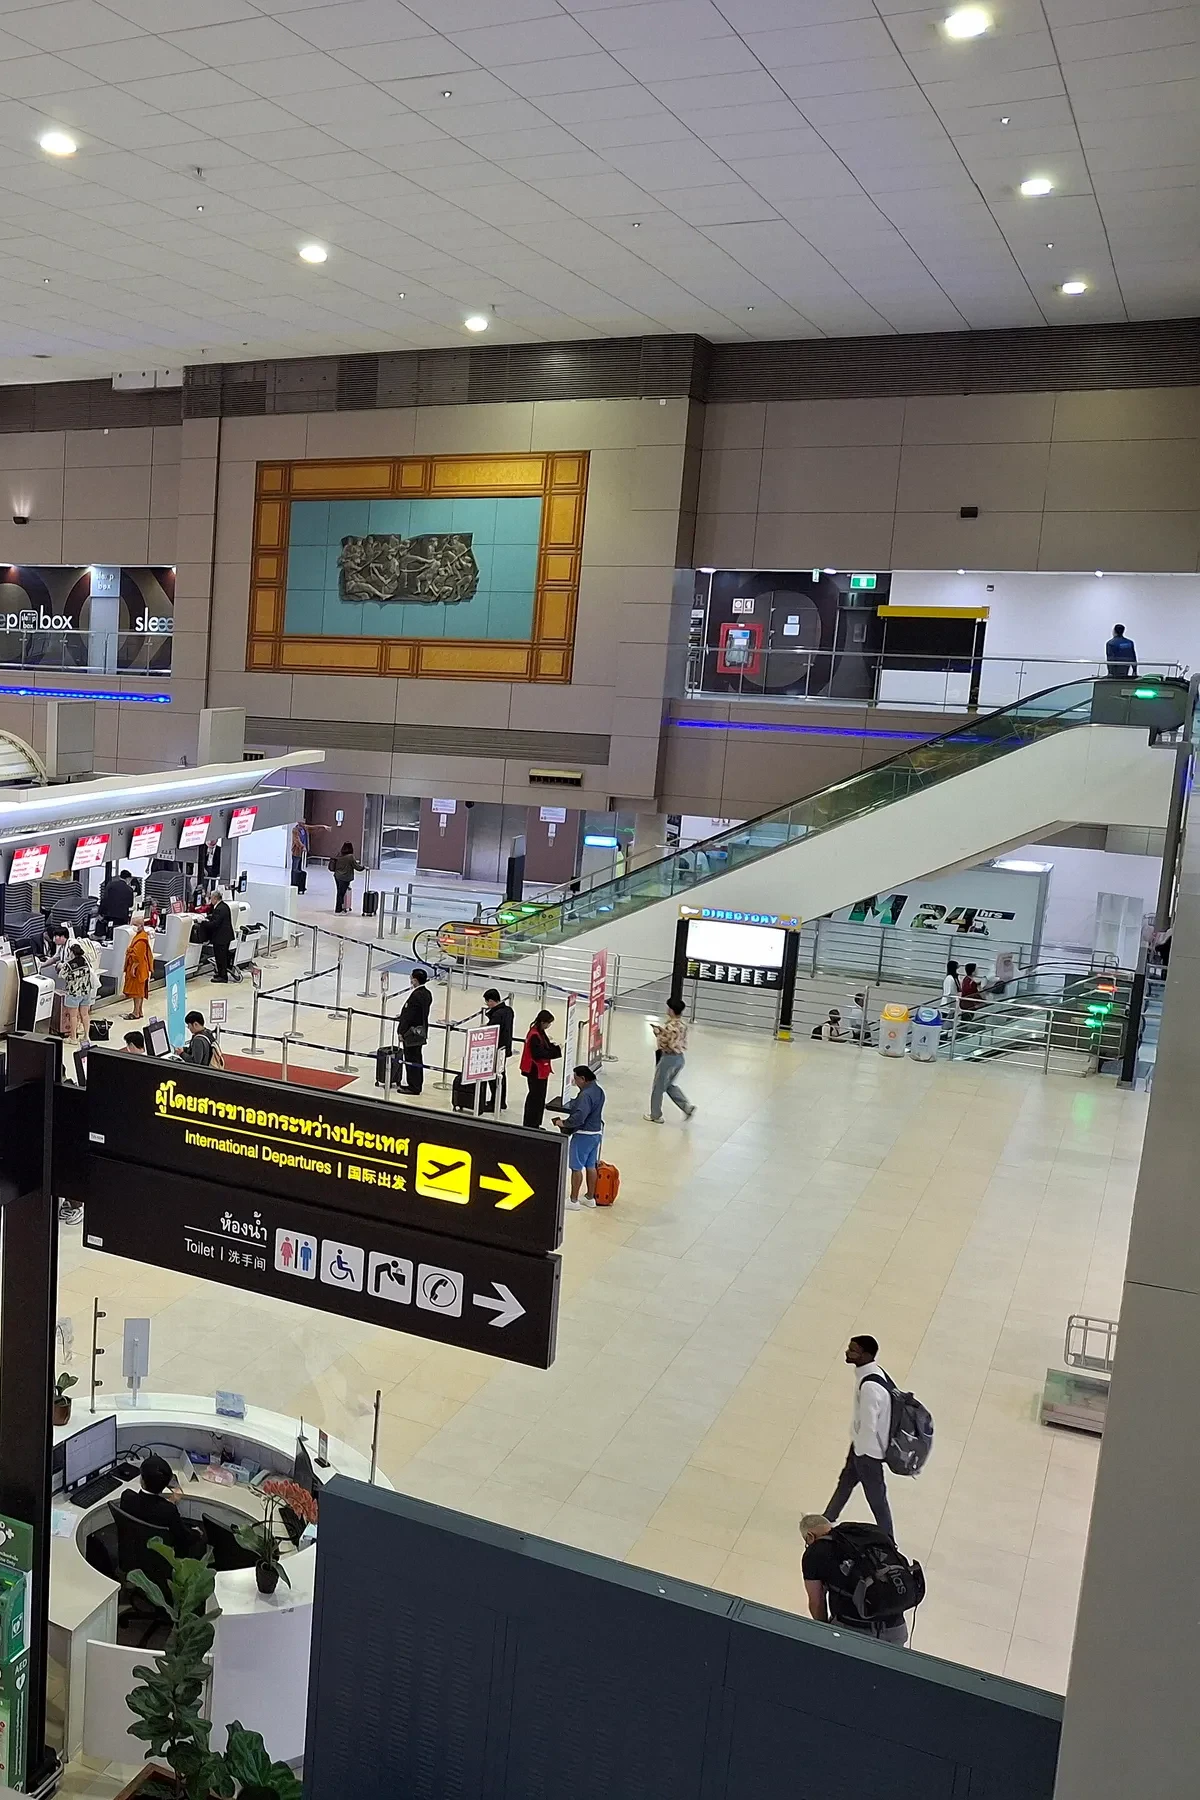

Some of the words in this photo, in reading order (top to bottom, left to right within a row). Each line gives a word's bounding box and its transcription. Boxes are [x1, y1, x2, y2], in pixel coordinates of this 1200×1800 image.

[40, 605, 72, 630] box
[58, 838, 66, 846] 9B
[702, 907, 778, 924] DIRECTORY
[910, 903, 978, 933] 24
[980, 909, 1003, 919] hrs
[472, 1032, 484, 1042] NO
[155, 1080, 410, 1156] ผู้โดยสารขาออกระหว่างประเทศ
[185, 1130, 258, 1159] International
[262, 1146, 332, 1175] Departures
[347, 1165, 407, 1192] 国际出发
[220, 1211, 268, 1241] ห้องน้ำ
[184, 1238, 214, 1258] Toilet
[228, 1250, 266, 1272] 洗手间
[14, 1658, 28, 1674] AED
